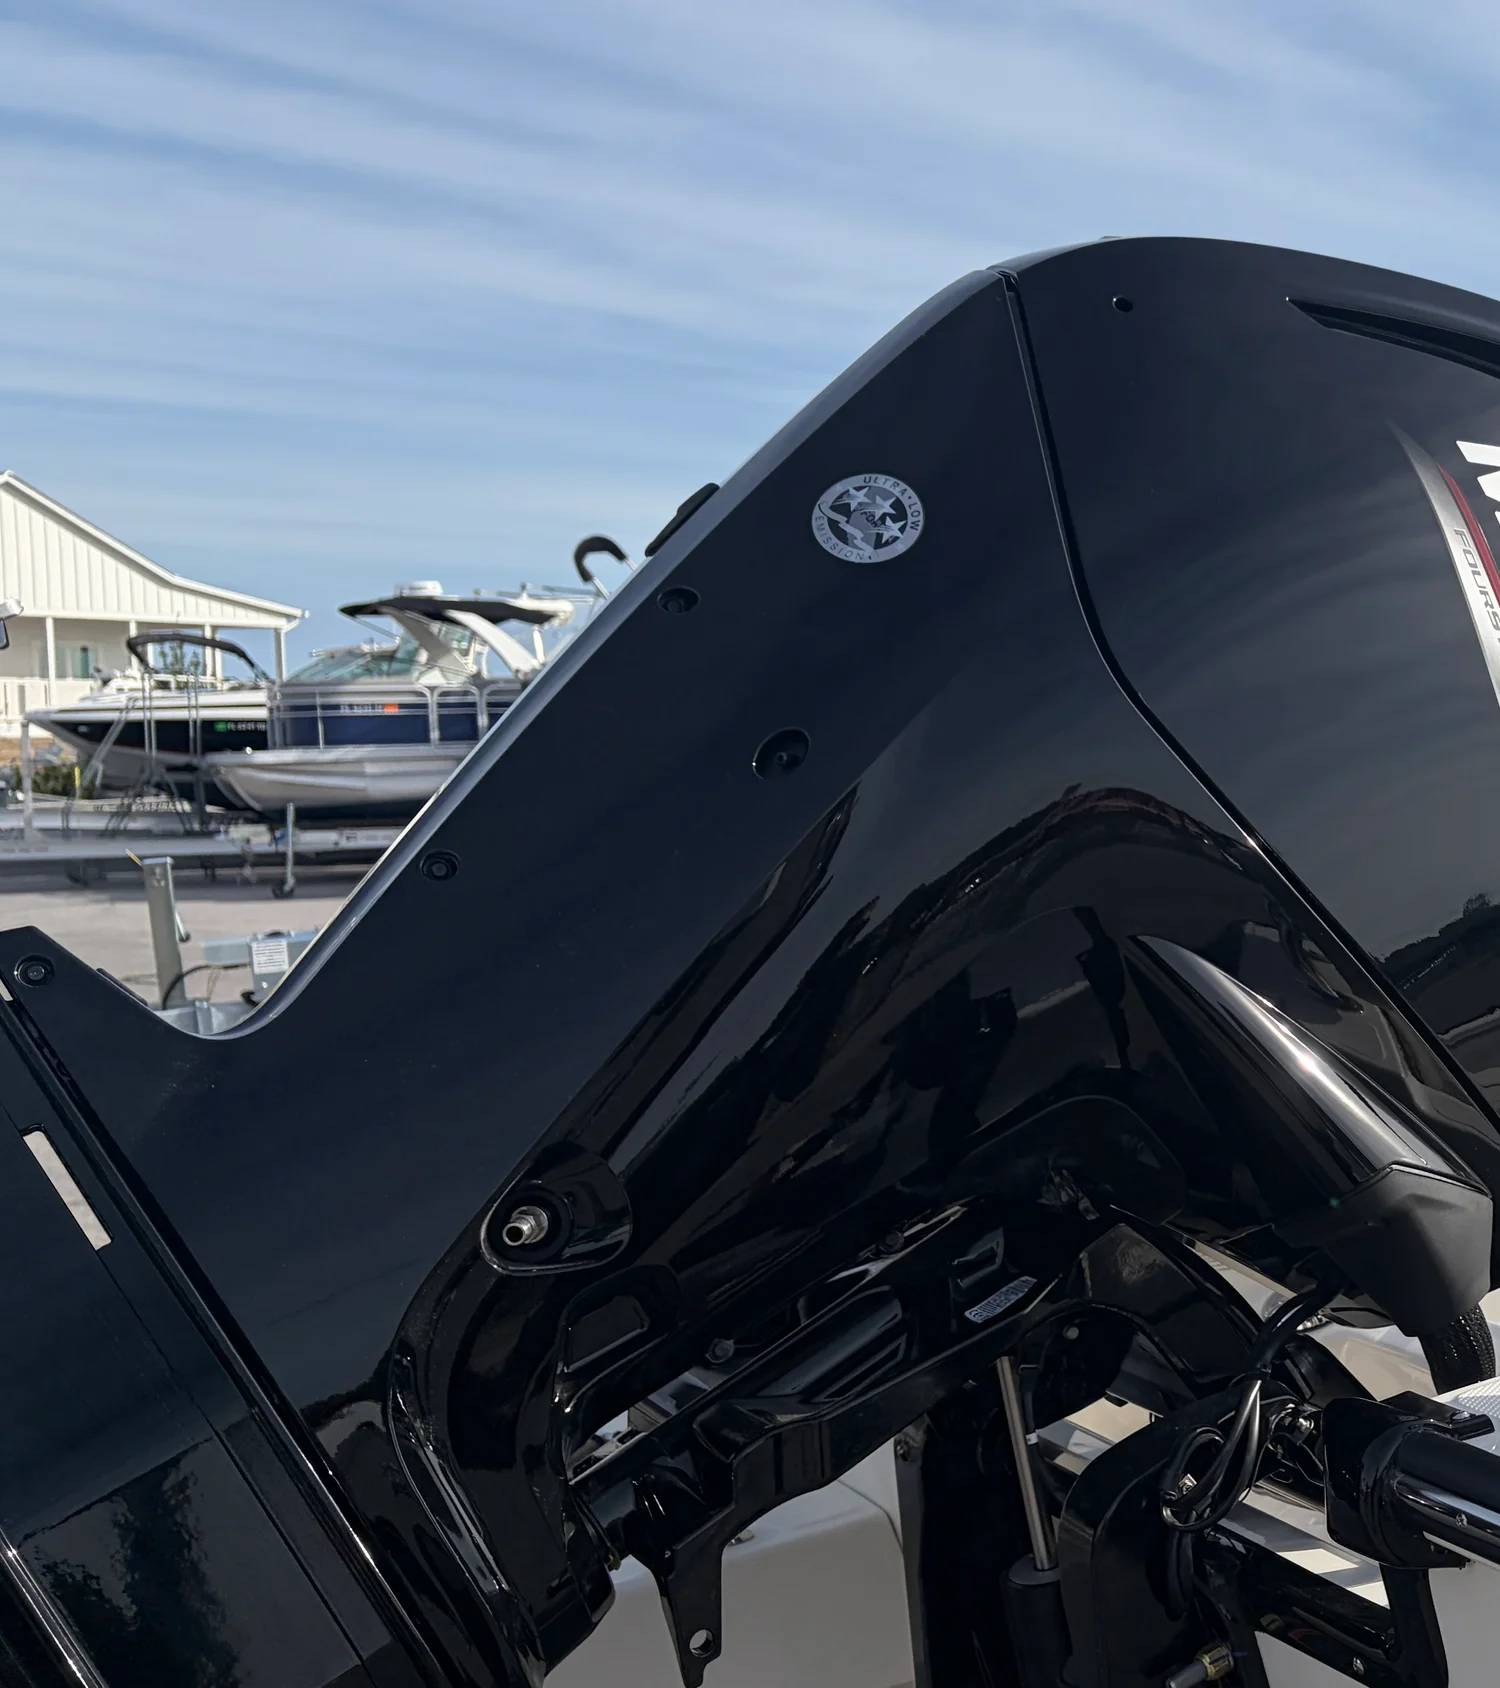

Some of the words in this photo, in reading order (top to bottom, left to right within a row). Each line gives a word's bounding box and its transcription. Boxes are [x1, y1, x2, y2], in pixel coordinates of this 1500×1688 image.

[863, 475, 908, 497] ULTRA
[907, 502, 921, 531] LOW
[815, 515, 864, 561] EMISSION
